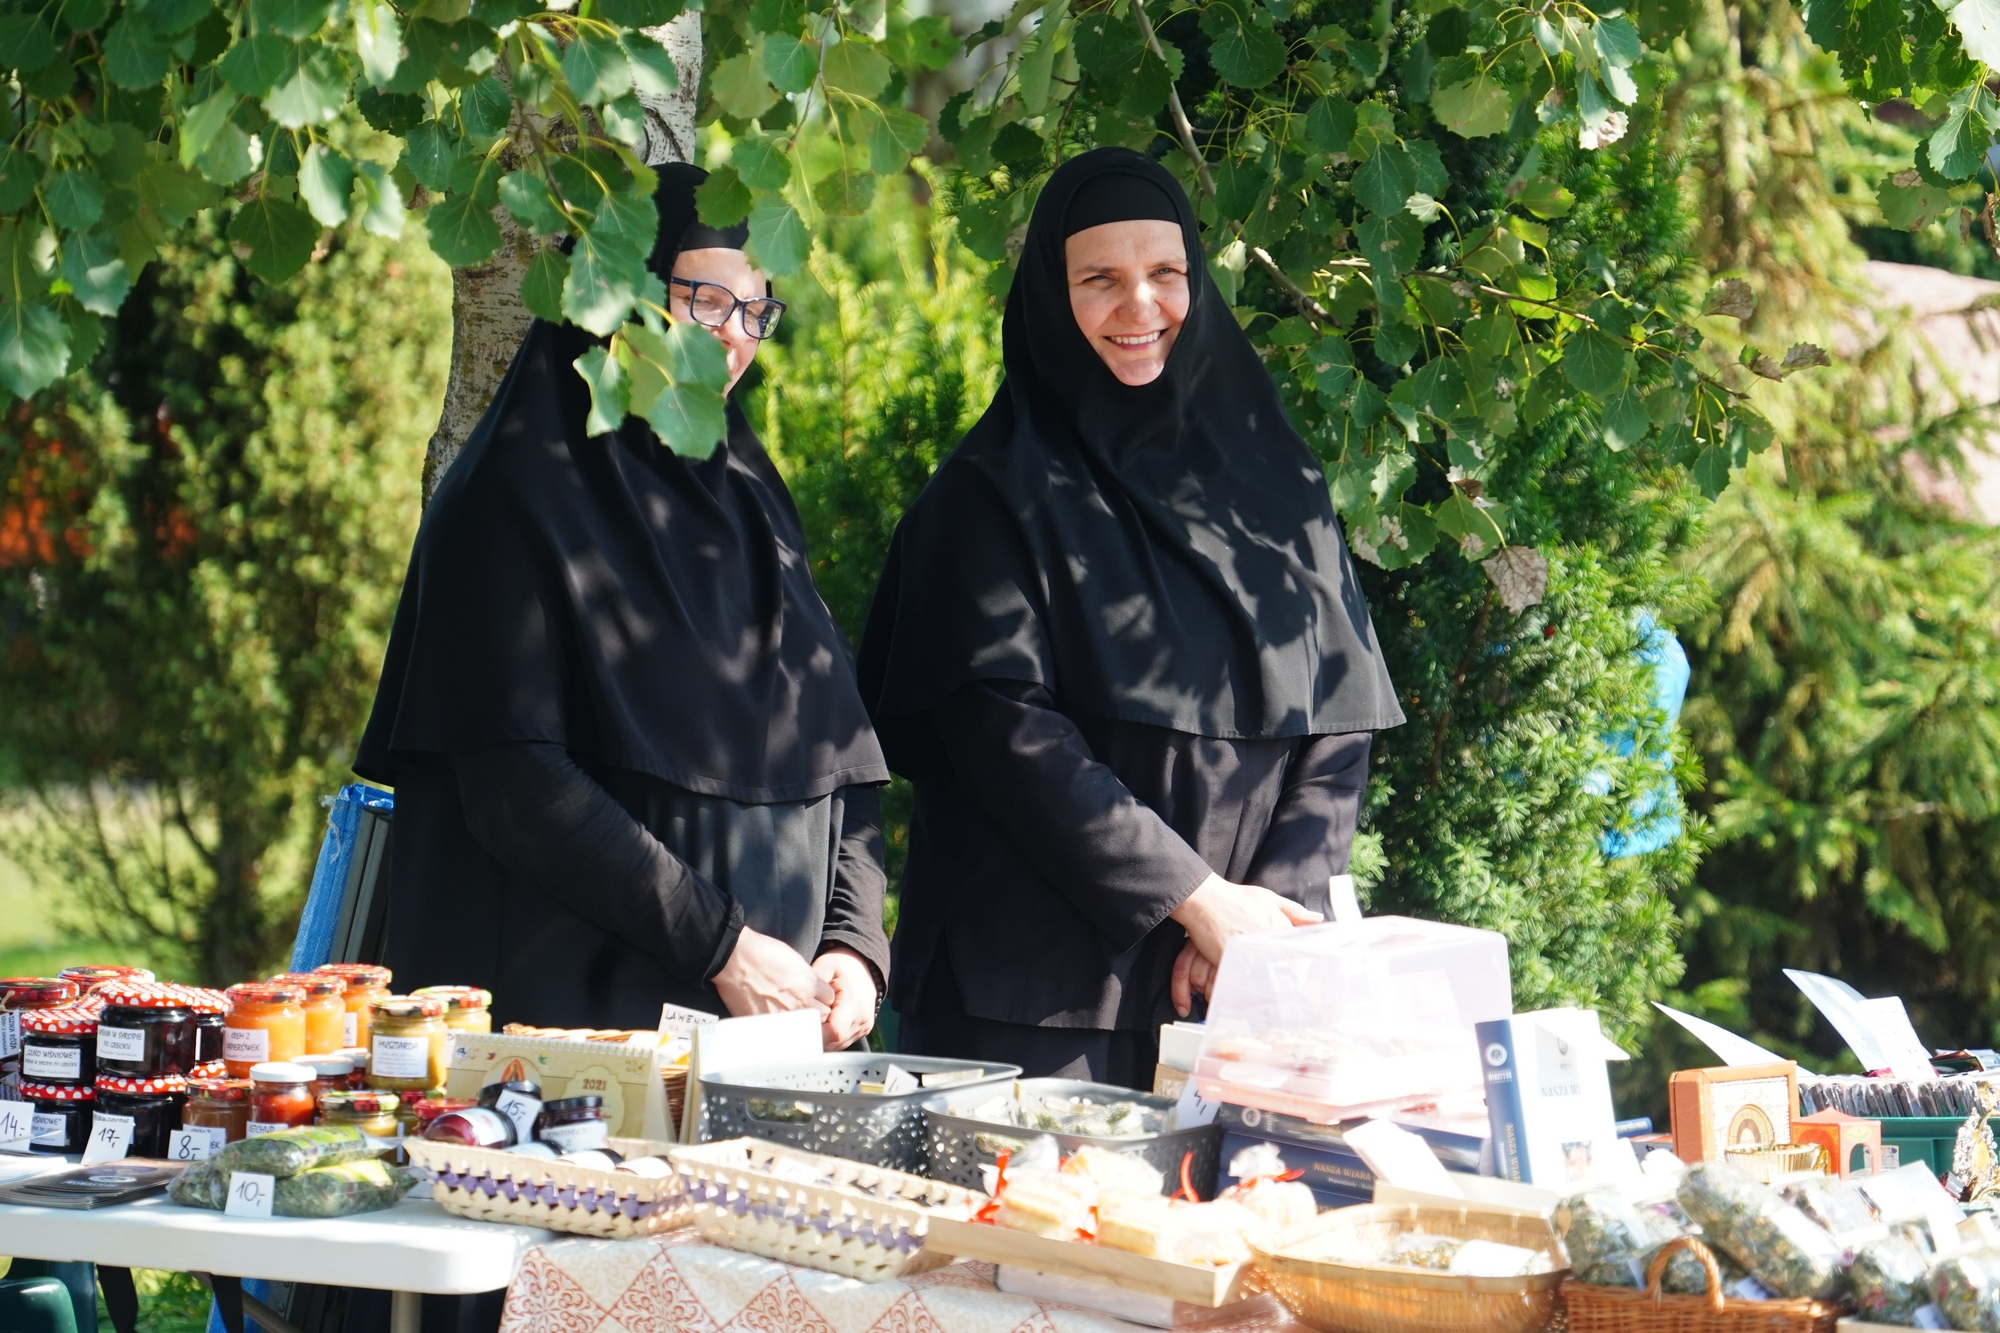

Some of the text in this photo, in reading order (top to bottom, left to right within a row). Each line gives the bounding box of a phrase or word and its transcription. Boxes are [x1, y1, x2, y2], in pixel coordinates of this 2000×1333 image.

[118, 1031, 142, 1041] SYROPIE
[246, 1032, 250, 1040] Z
[378, 1039, 418, 1050] MUSZTARDA
[582, 1078, 607, 1091] 2021
[1506, 1124, 1515, 1156] NASZA
[1314, 1162, 1372, 1182] NASZA WIARA
